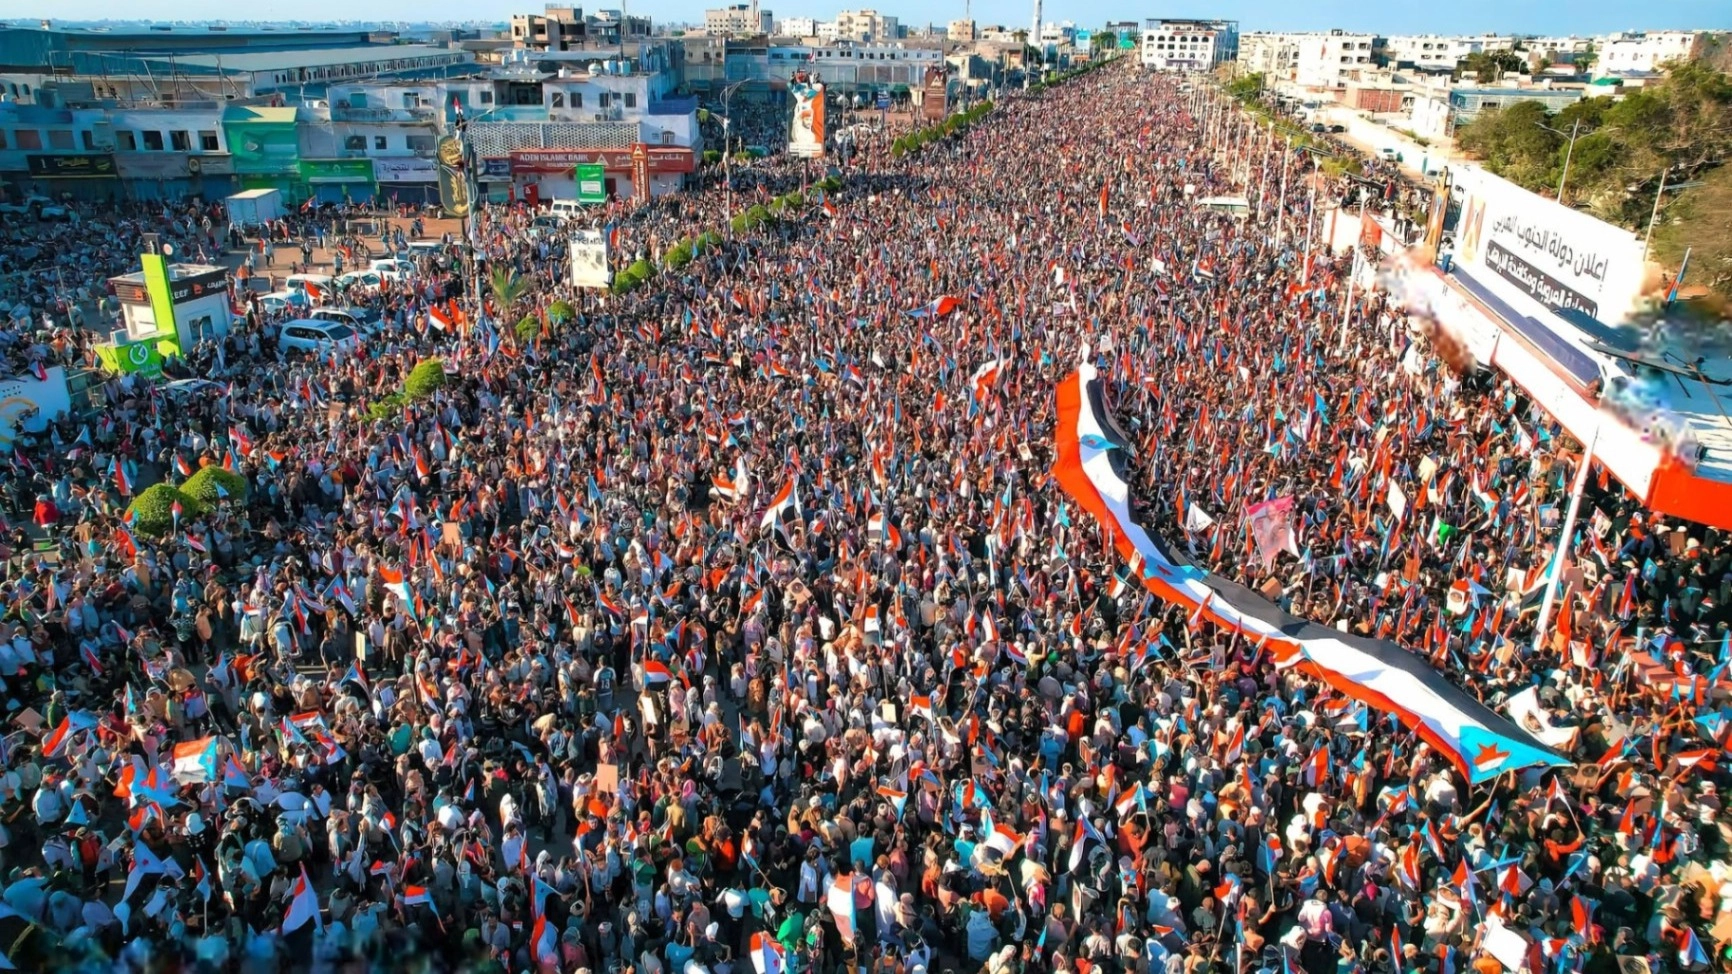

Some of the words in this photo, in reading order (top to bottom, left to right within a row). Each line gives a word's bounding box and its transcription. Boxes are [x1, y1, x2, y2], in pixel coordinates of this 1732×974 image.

[520, 153, 540, 161] ADEN
[541, 153, 568, 161] ISLAMIC
[568, 153, 589, 162] BANK
[1492, 215, 1518, 237] العربي
[1517, 225, 1550, 254] الجنوب
[1548, 231, 1574, 268] دولة
[1507, 256, 1538, 294] ومكافحة
[1574, 252, 1609, 292] إعلان
[1536, 274, 1566, 309] العروبة
